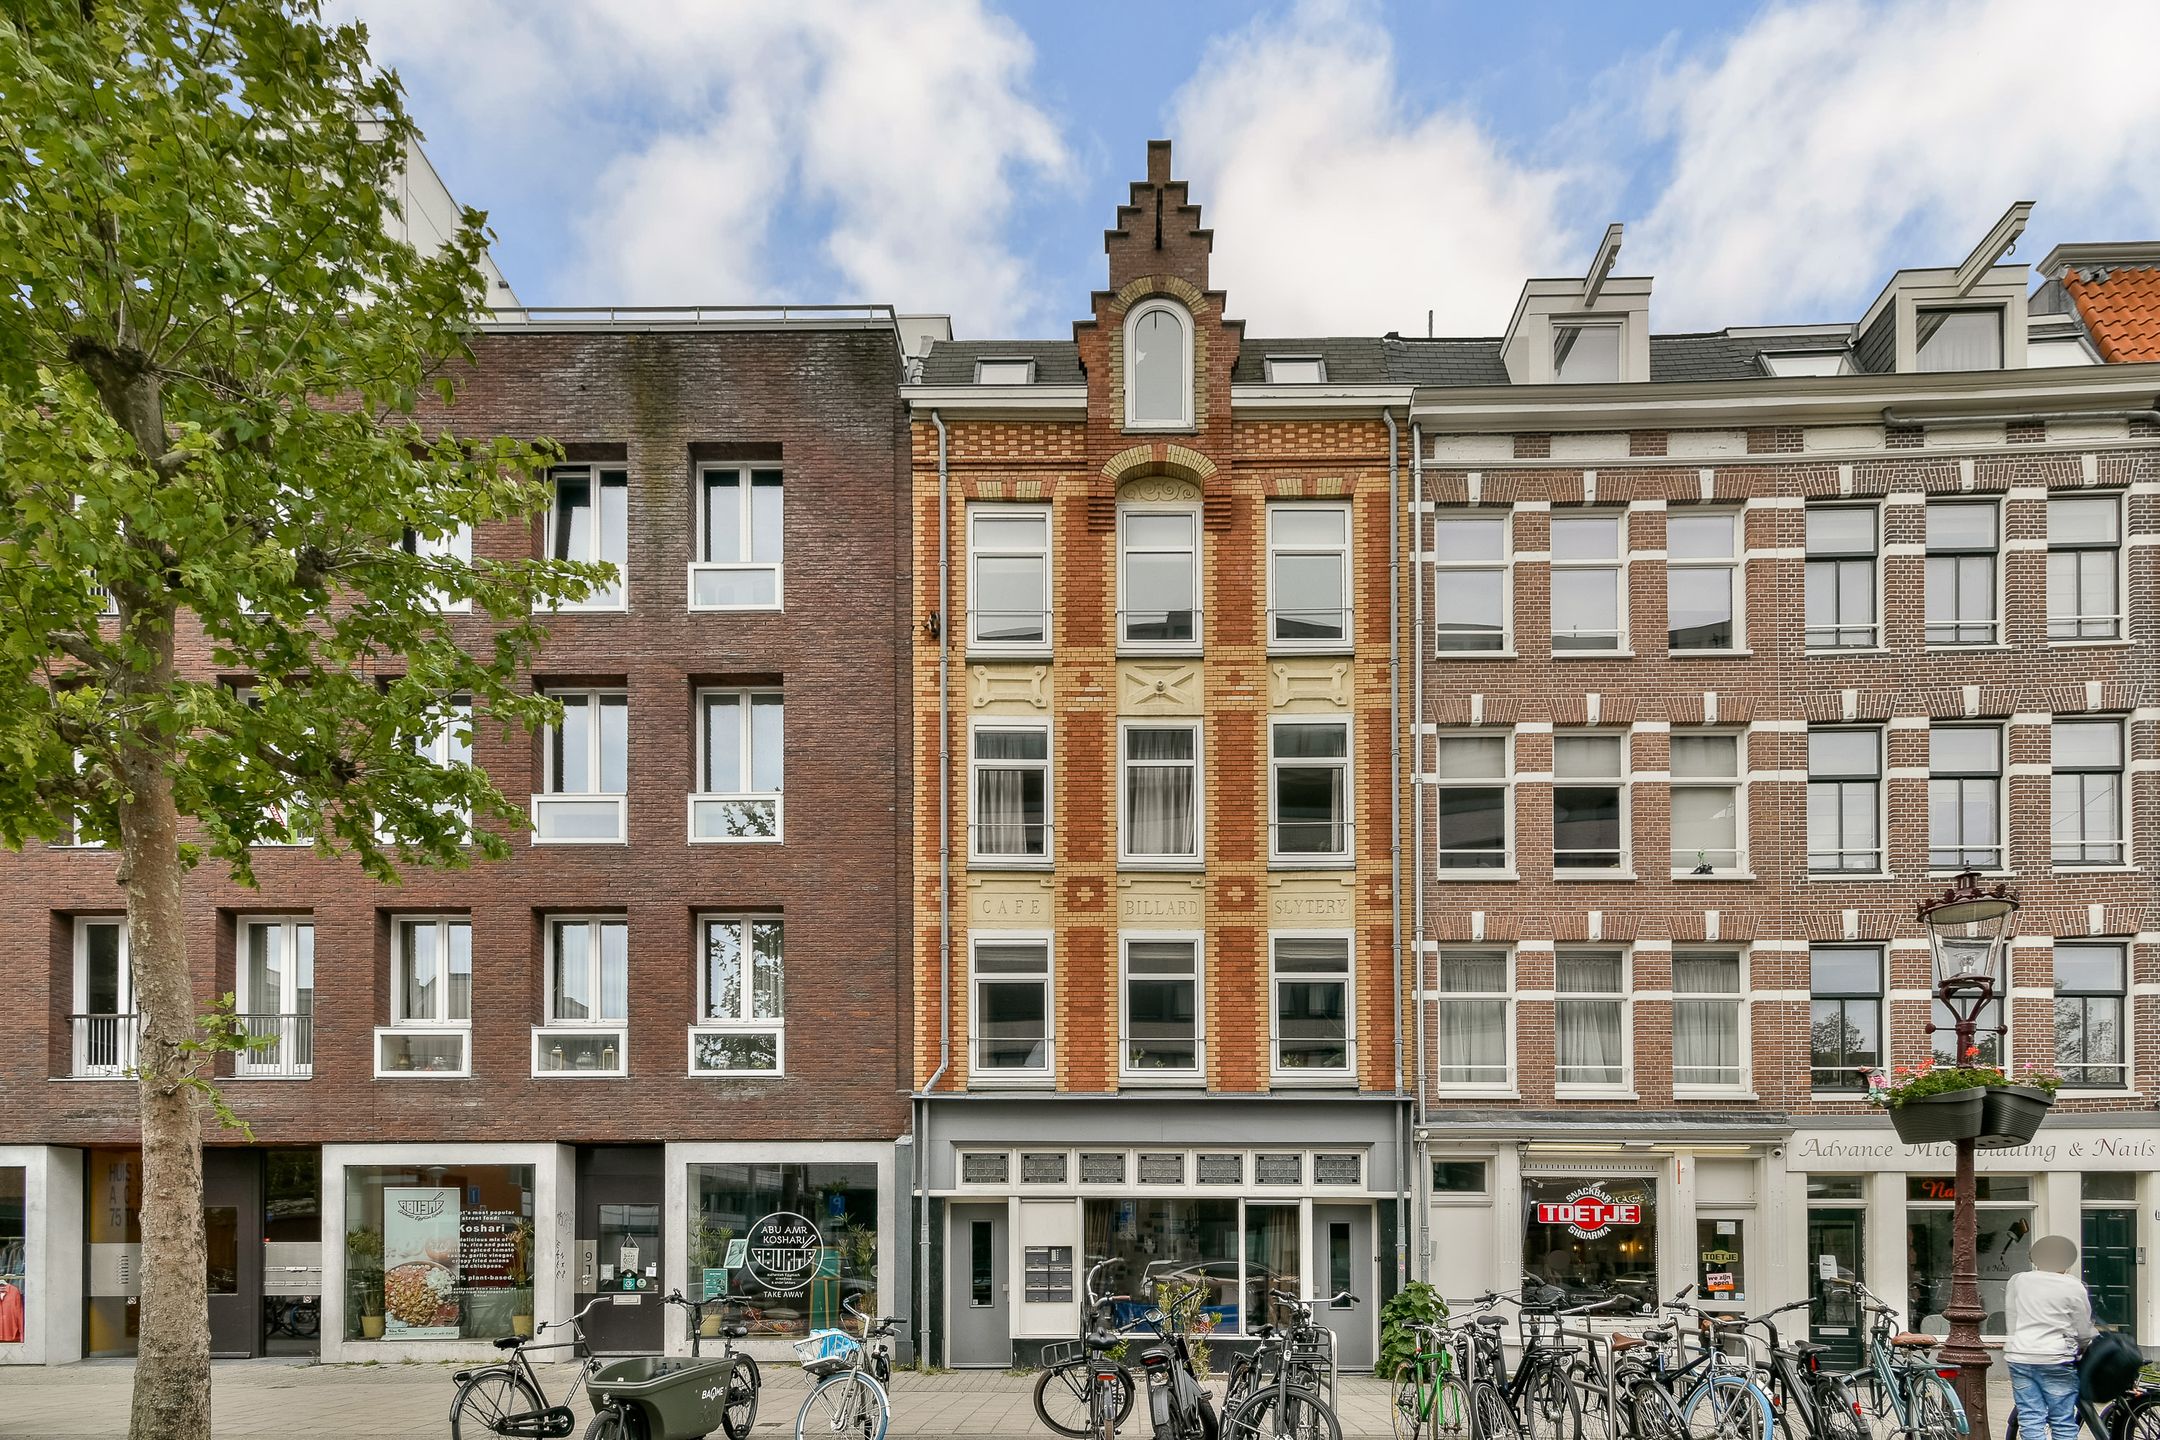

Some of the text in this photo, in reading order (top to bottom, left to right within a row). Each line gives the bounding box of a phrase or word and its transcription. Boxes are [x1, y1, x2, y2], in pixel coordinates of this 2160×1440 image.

[982, 899, 1041, 914] CAFE
[1125, 900, 1197, 915] BILLARD
[1275, 899, 1347, 914] SLYTERY
[1799, 1138, 1893, 1157] Advance
[2068, 1141, 2084, 1157] &
[2092, 1137, 2156, 1157] Nails
[1566, 1187, 1612, 1204] SNACKBAR
[1543, 1205, 1635, 1222] TOETJE
[460, 1224, 505, 1232] Koshari
[761, 1226, 807, 1234] ABU AMR
[1568, 1225, 1611, 1240] SHOARMA
[763, 1236, 805, 1244] KOSHARI
